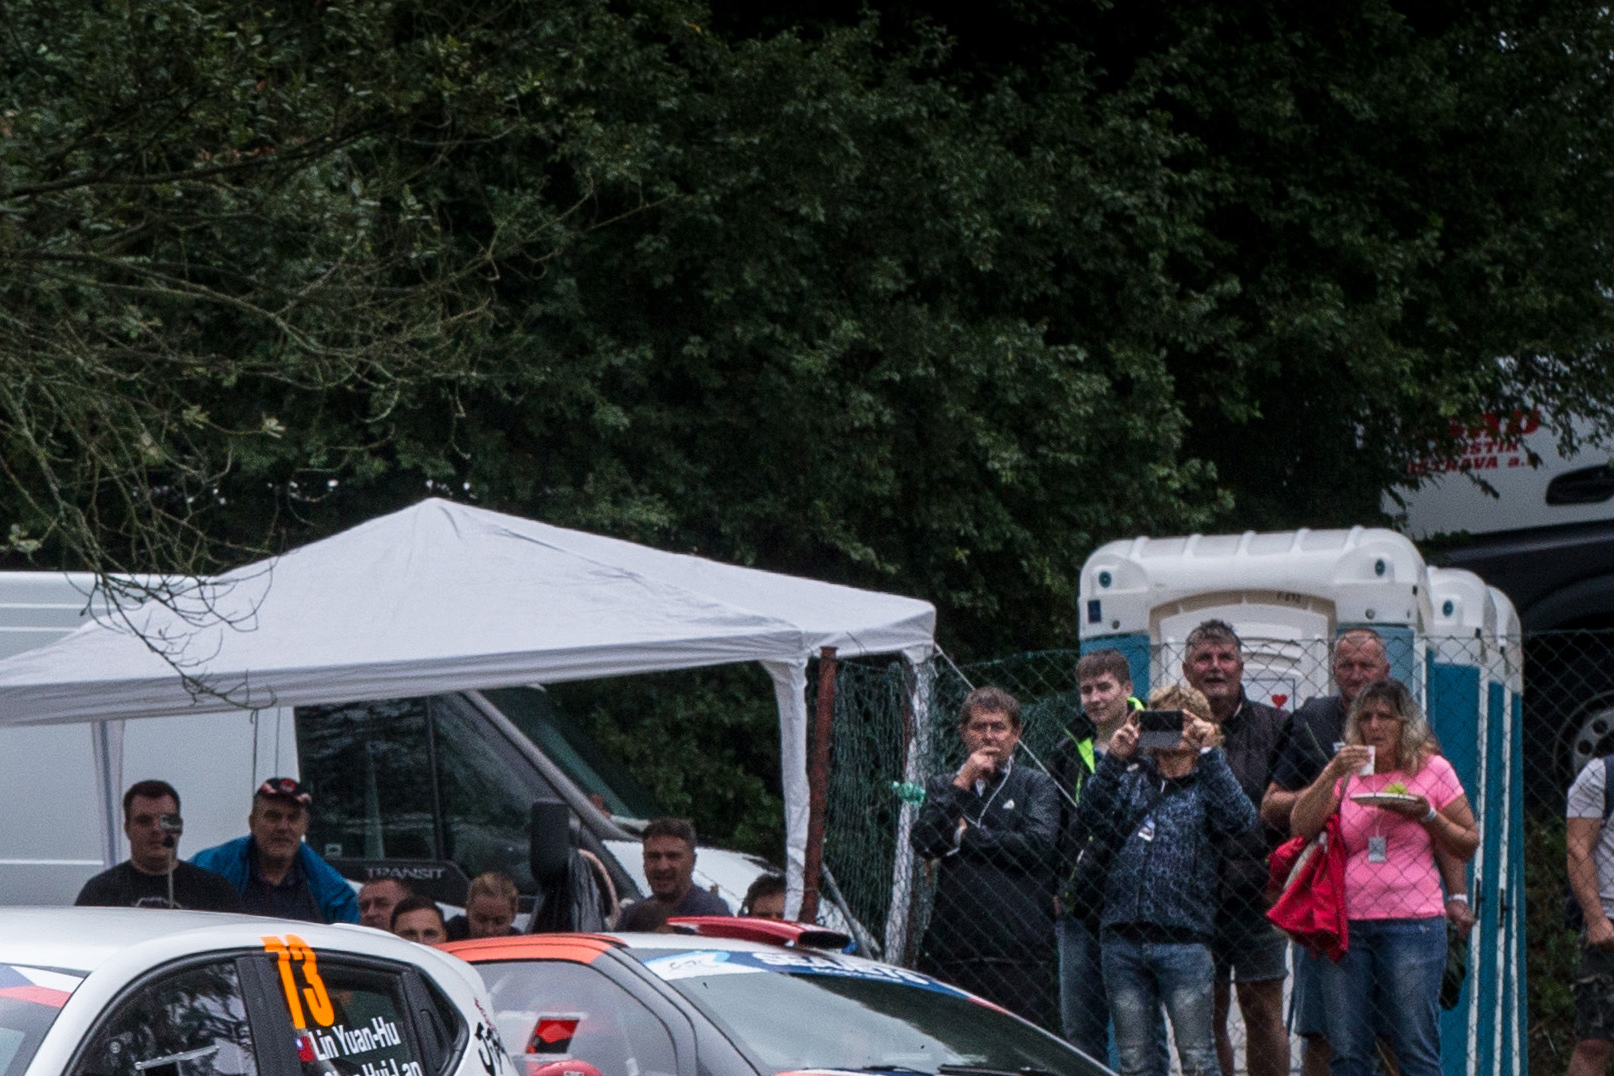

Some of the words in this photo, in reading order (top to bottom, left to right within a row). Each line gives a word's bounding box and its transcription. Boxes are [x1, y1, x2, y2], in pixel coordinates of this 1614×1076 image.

[365, 866, 445, 880] TRANSIT
[260, 933, 335, 1030] 73
[308, 1029, 340, 1062] Lin
[332, 1015, 402, 1057] Yuan-Hu
